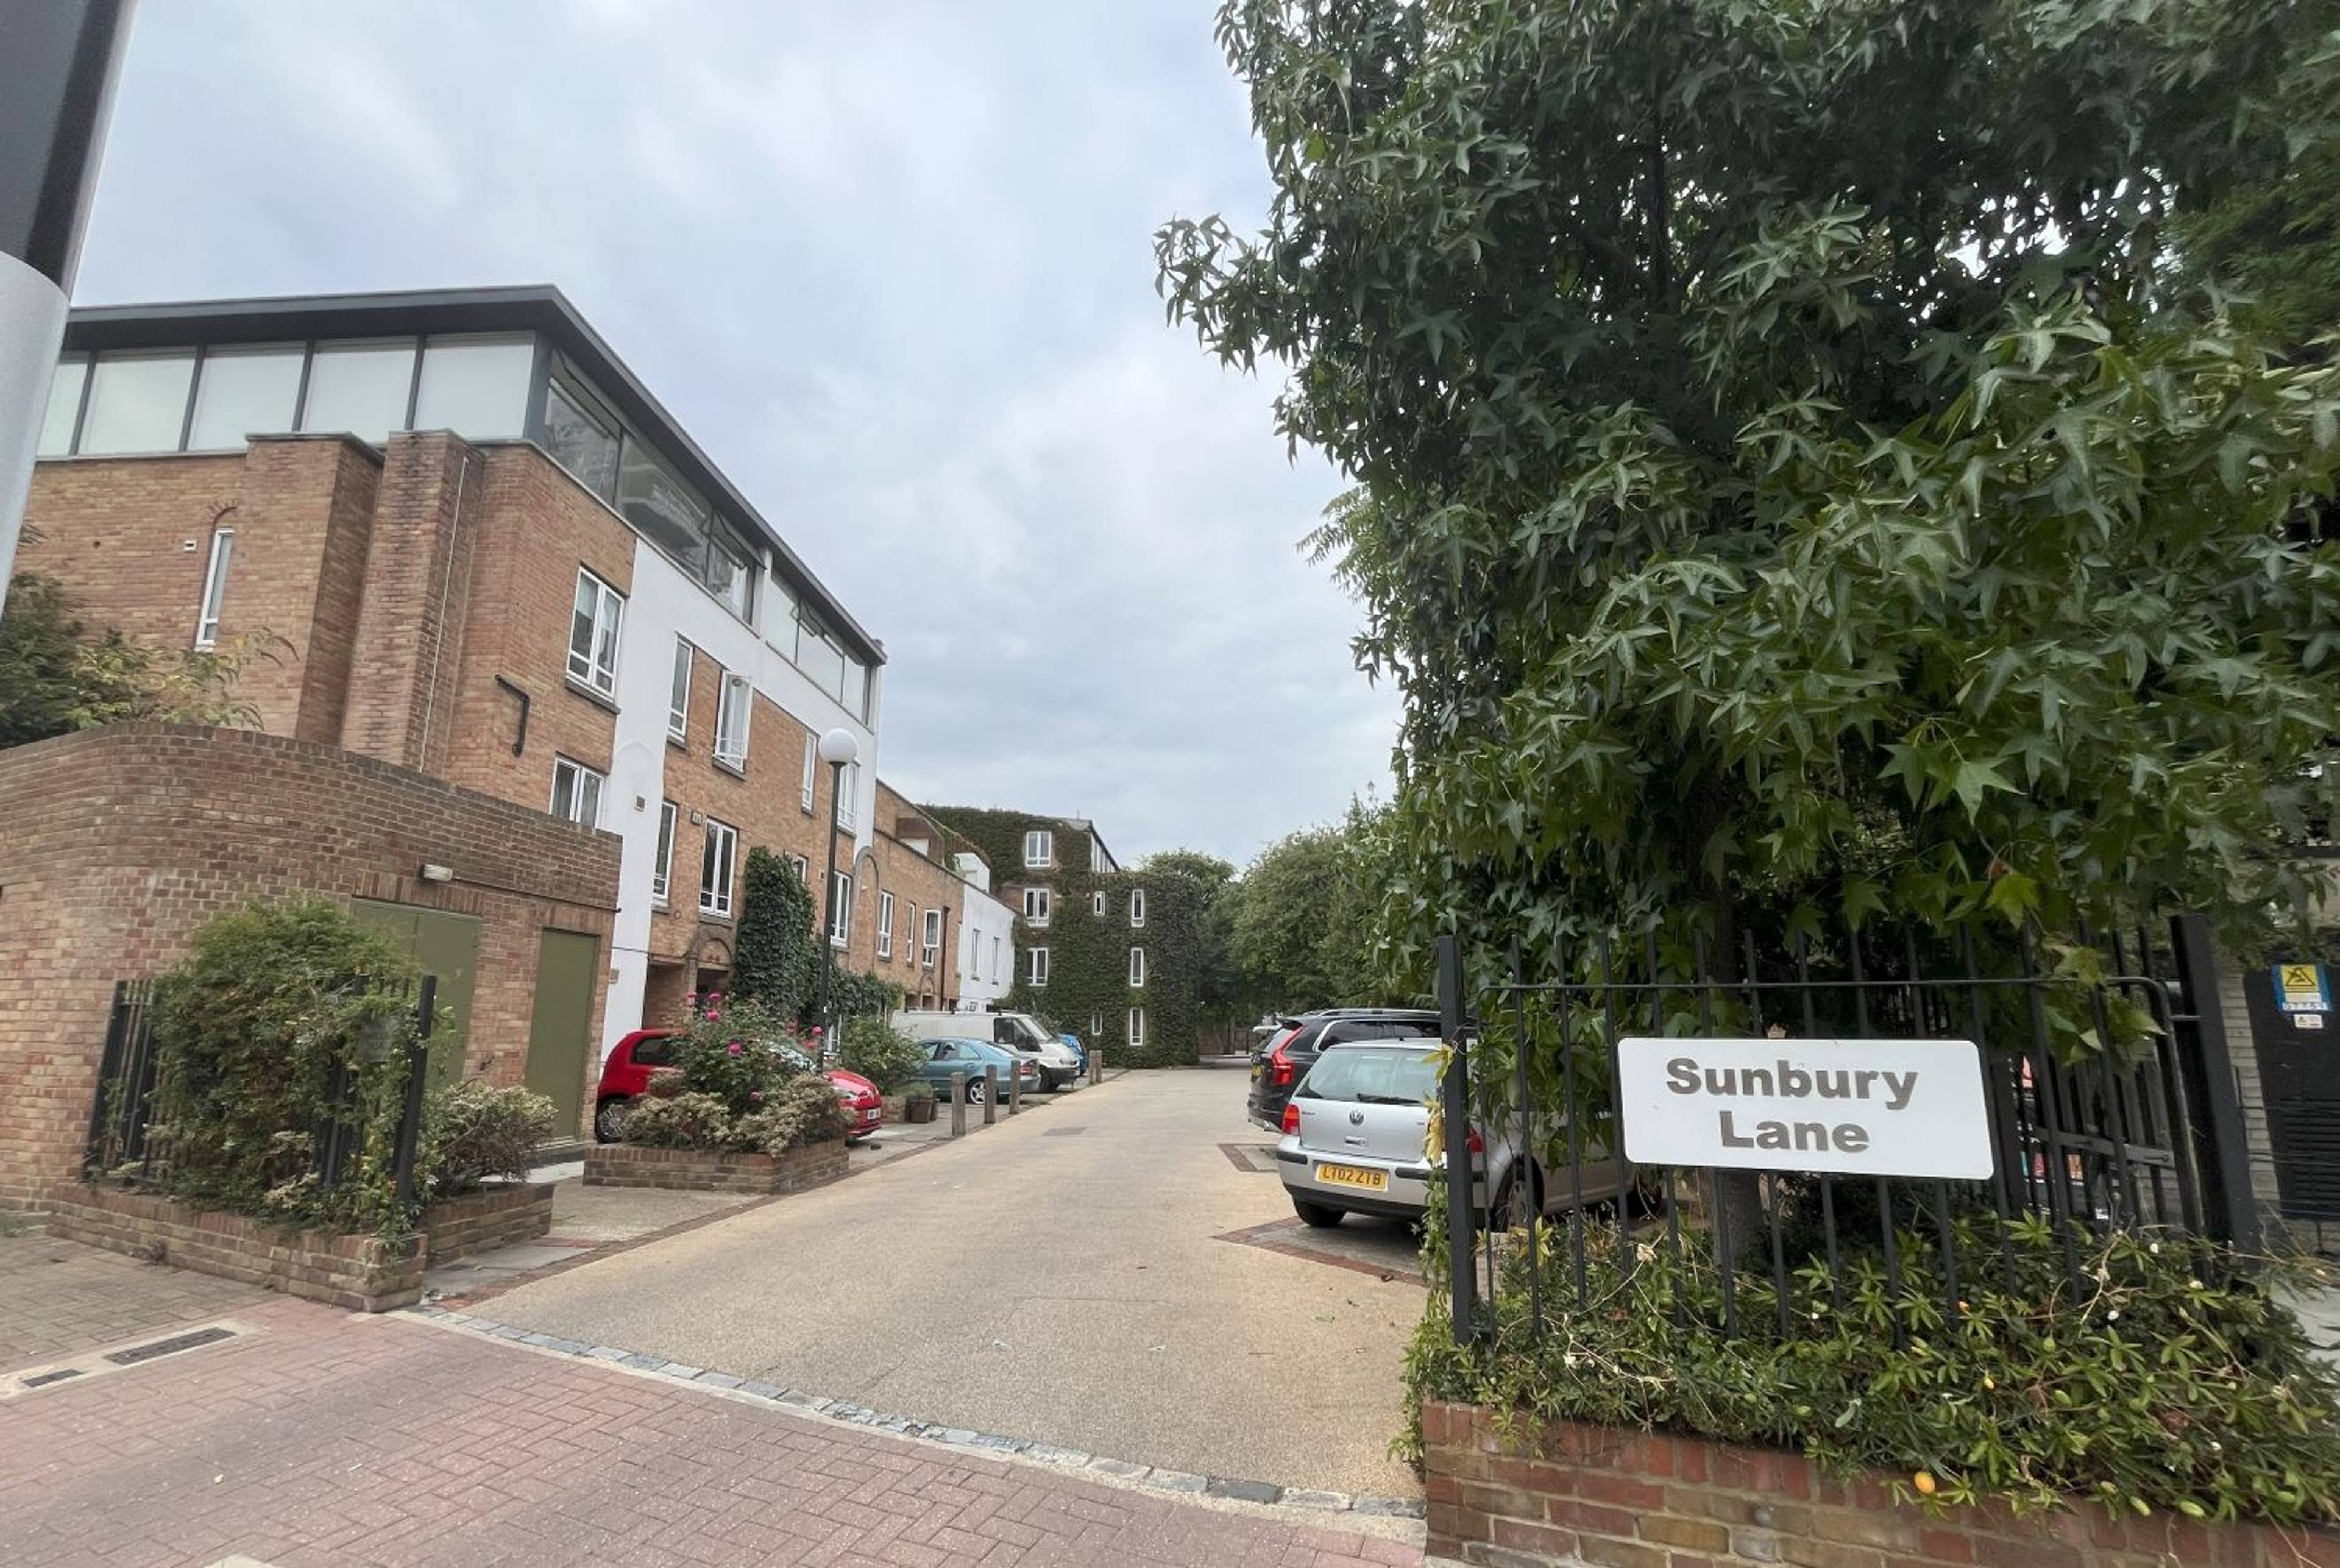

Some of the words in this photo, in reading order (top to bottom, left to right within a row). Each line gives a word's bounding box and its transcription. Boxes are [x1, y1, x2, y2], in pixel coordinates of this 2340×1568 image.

[1666, 1057, 1918, 1110] Sunbury
[1719, 1110, 1870, 1154] Lane
[1322, 1165, 1353, 1182] LT02
